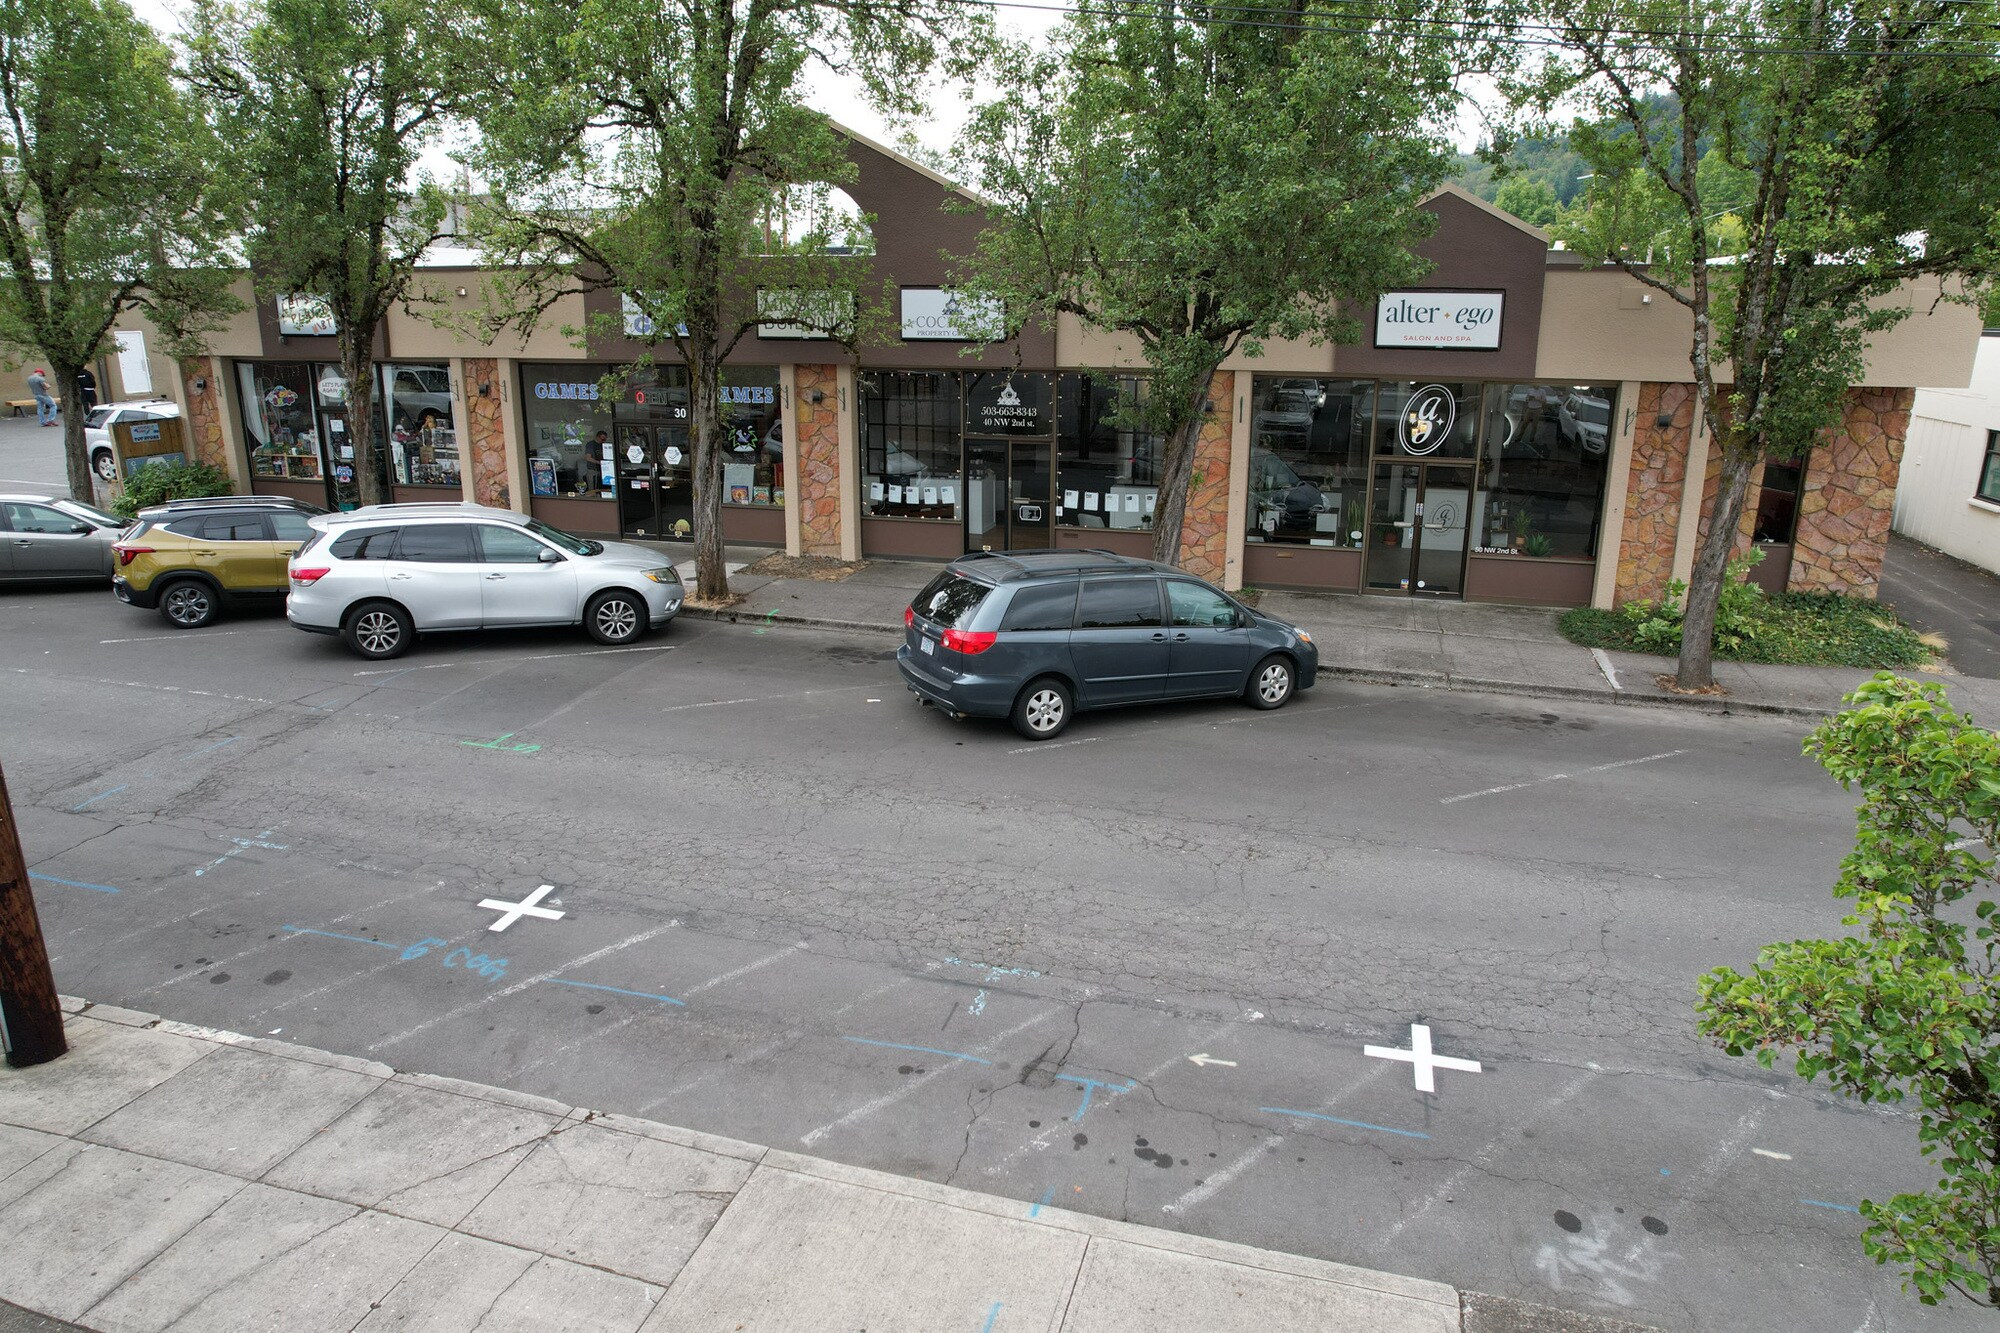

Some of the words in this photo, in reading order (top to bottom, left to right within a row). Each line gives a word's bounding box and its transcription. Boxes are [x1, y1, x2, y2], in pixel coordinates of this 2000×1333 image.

[1386, 299, 1440, 323] alter
[1455, 307, 1494, 331] ego
[535, 383, 599, 400] GAMES
[635, 390, 668, 405] OPEN
[720, 386, 774, 403] AMES
[674, 408, 687, 418] 30
[980, 406, 1037, 417] 503-663-8343
[983, 418, 992, 426] 40
[993, 418, 1010, 426] NW
[1011, 418, 1026, 427] 2nd
[1483, 546, 1497, 554] NW
[1496, 547, 1510, 555] 2nd
